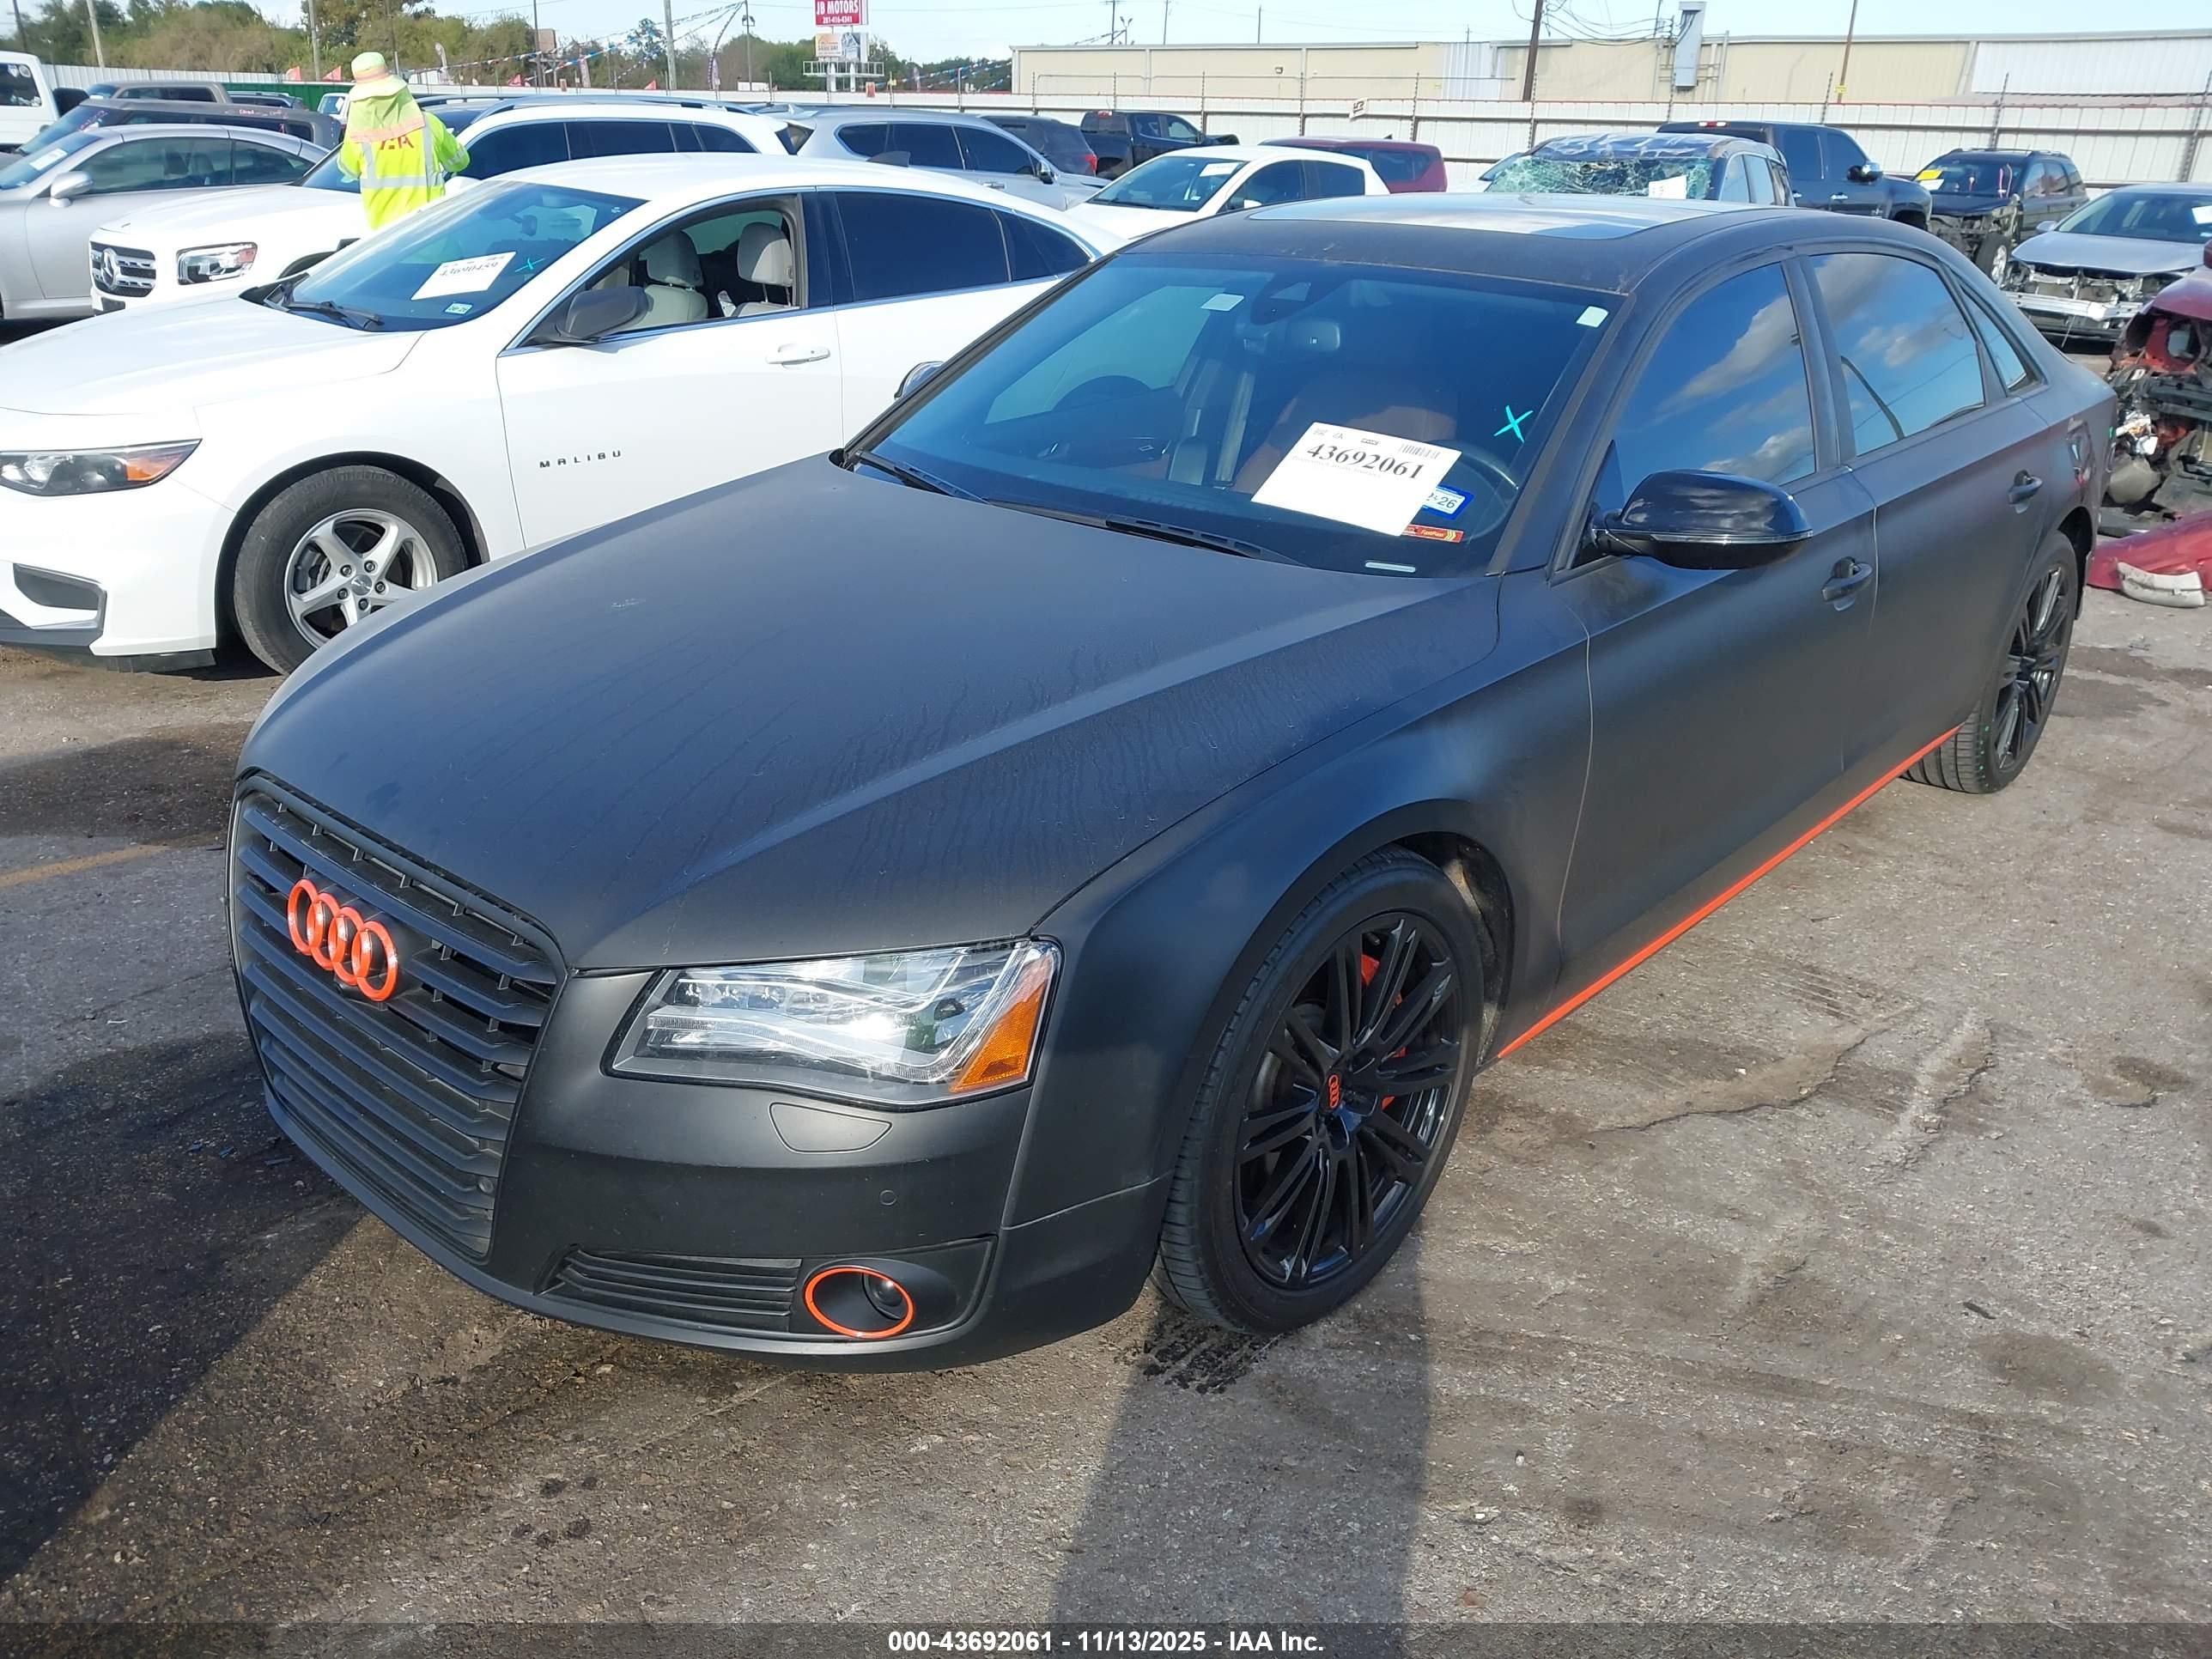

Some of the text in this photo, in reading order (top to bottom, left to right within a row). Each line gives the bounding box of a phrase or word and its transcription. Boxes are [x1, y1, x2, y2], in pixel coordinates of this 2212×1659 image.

[817, 0, 859, 15] JB MOTORS
[539, 450, 621, 468] MALIBU
[1307, 443, 1425, 479] 43692061
